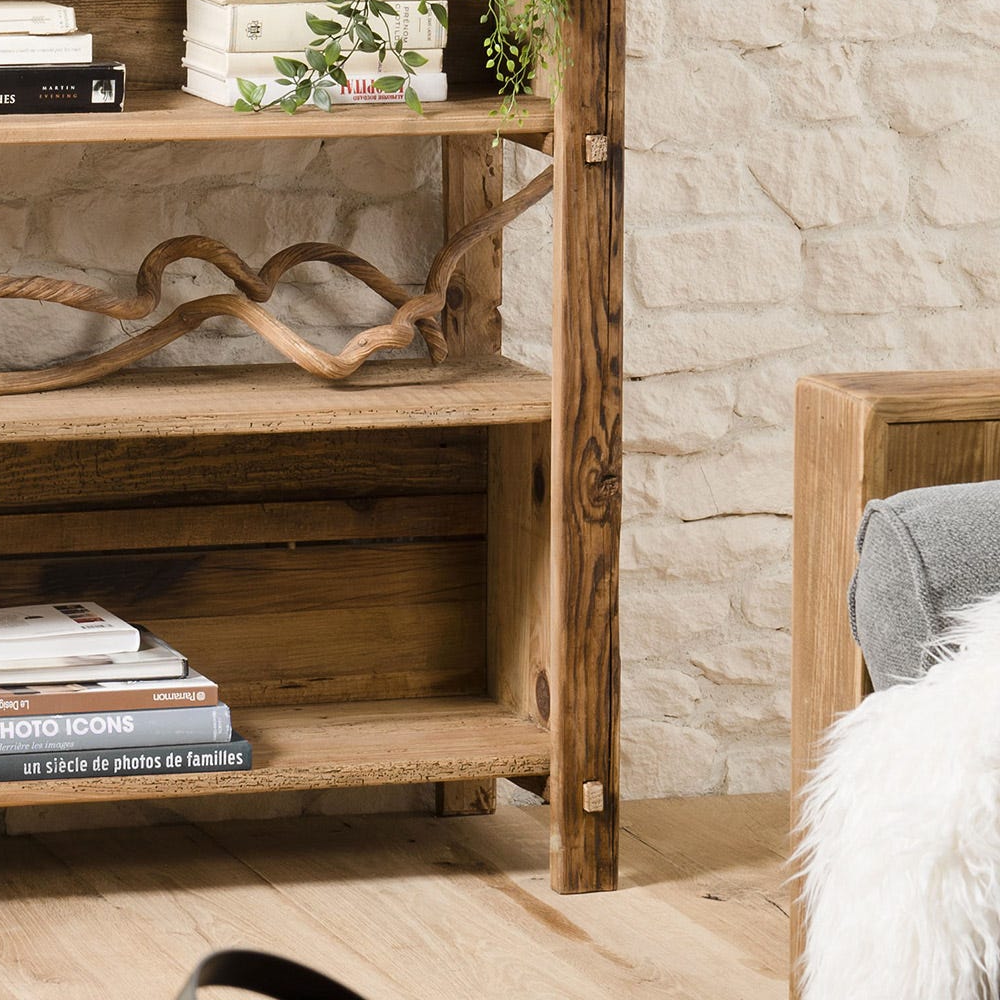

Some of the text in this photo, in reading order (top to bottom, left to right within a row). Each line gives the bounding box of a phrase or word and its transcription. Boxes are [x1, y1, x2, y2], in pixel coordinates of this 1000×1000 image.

[153, 691, 196, 701] Parramon
[20, 700, 30, 710] Le
[65, 715, 135, 736] ICONS
[31, 740, 43, 750] les
[44, 741, 75, 751] images
[23, 750, 244, 775] un siècle de photos de familles
